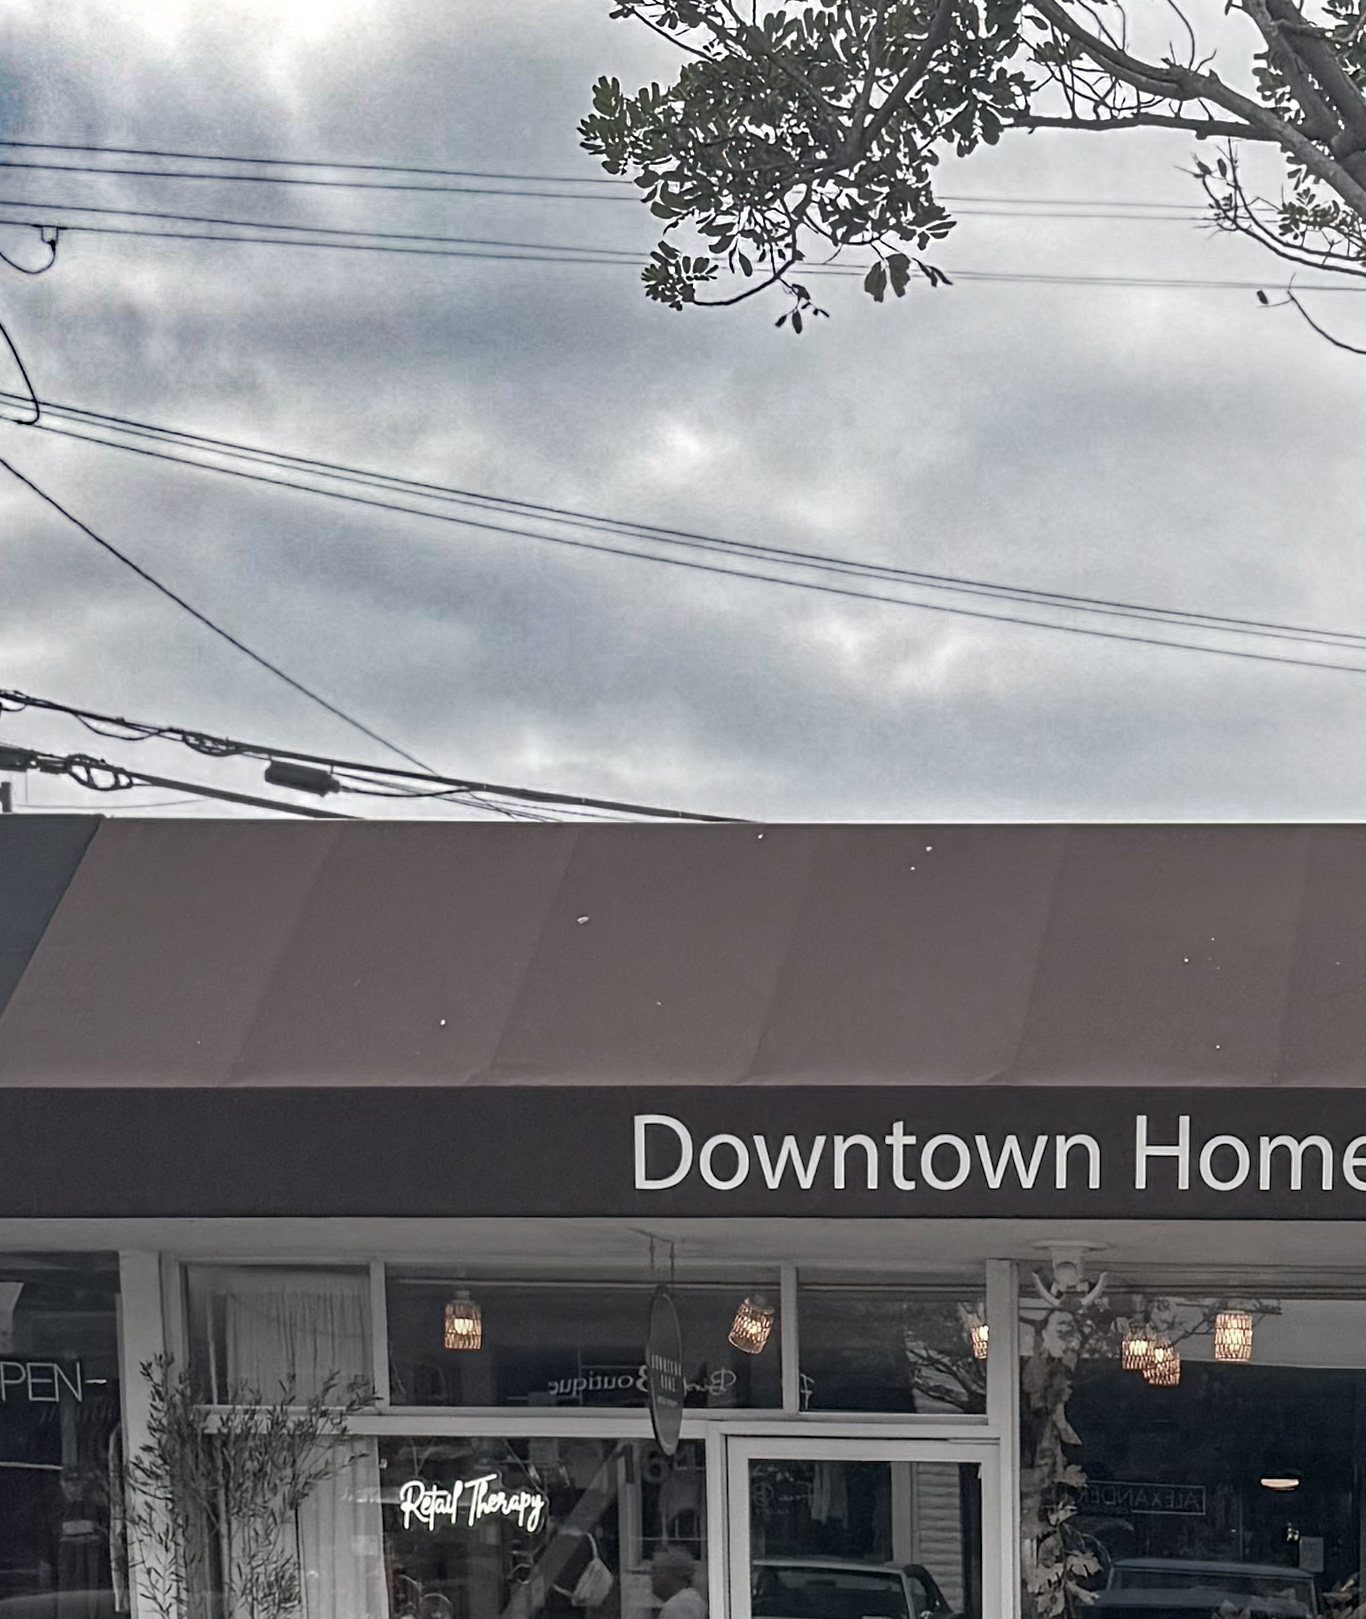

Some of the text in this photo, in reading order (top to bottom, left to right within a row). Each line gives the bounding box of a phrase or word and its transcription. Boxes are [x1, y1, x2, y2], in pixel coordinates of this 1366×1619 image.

[633, 1114, 1100, 1191] Downtown
[400, 1473, 545, 1533] Retail Therapy
